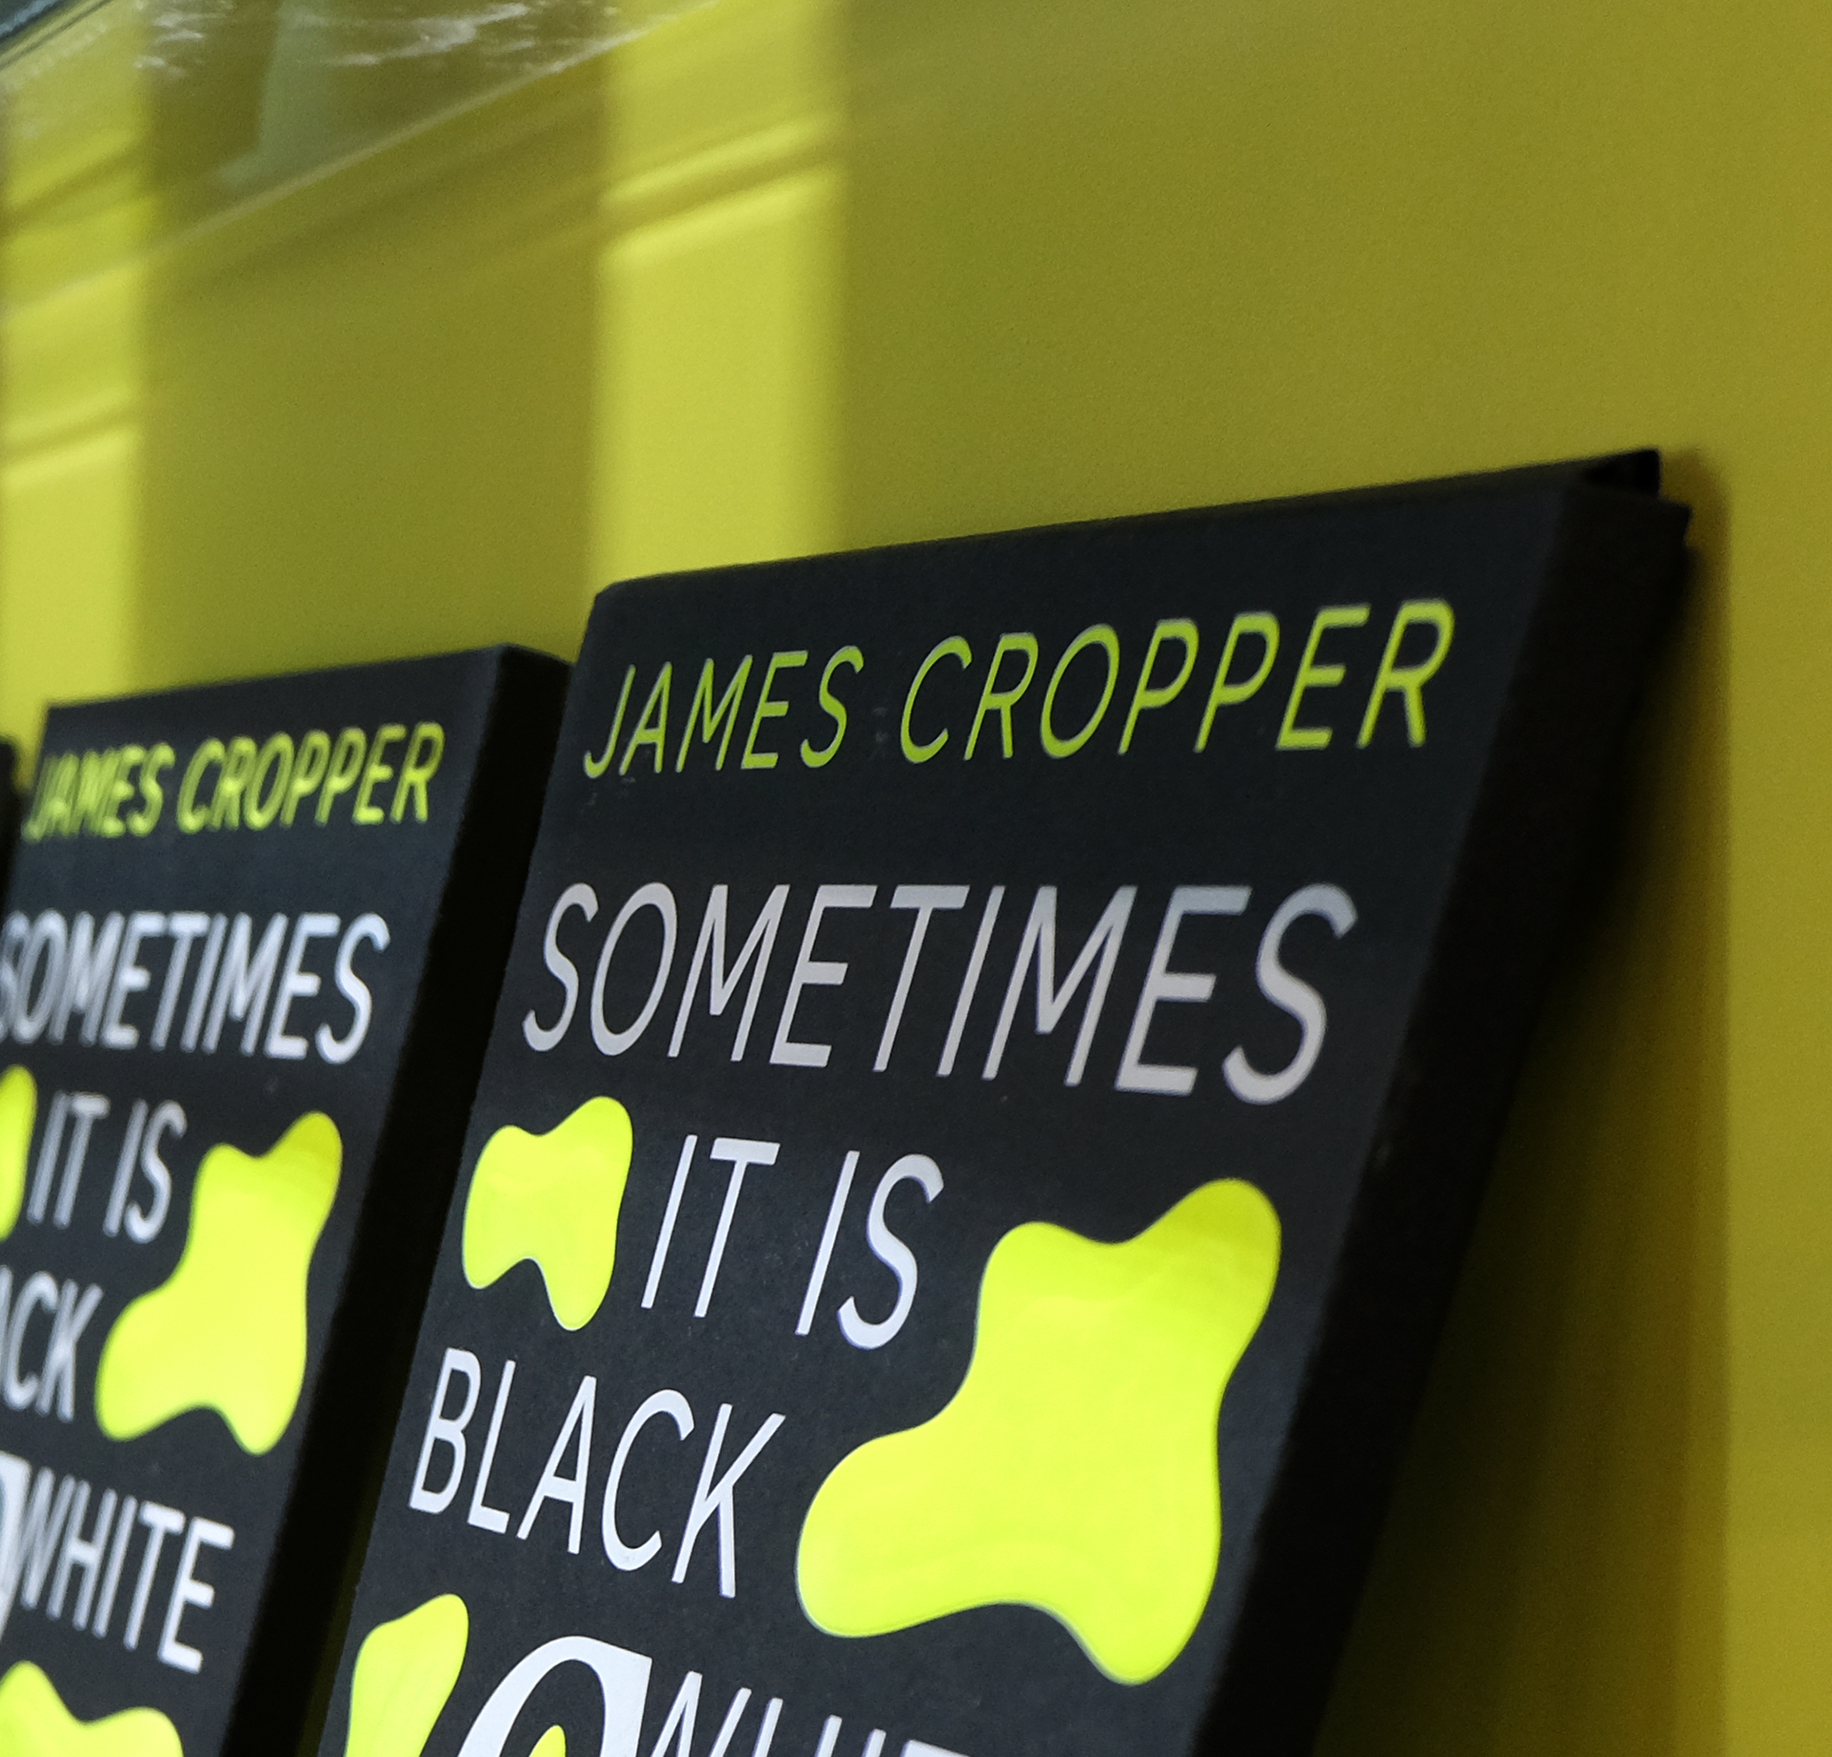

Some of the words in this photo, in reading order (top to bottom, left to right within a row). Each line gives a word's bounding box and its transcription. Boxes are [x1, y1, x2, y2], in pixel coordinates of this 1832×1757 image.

[21, 743, 175, 842] JAMES
[177, 721, 444, 834] CROPPER
[583, 643, 863, 778] JAMES
[898, 600, 1455, 762] CROPPER
[523, 882, 1359, 1104] SOMETIMES
[26, 1092, 110, 1229] IT
[103, 1100, 188, 1243] IS
[640, 1134, 780, 1318] IT
[795, 1150, 944, 1349] IS
[9, 1466, 235, 1674] WHITE
[408, 1348, 786, 1598] BLACK
